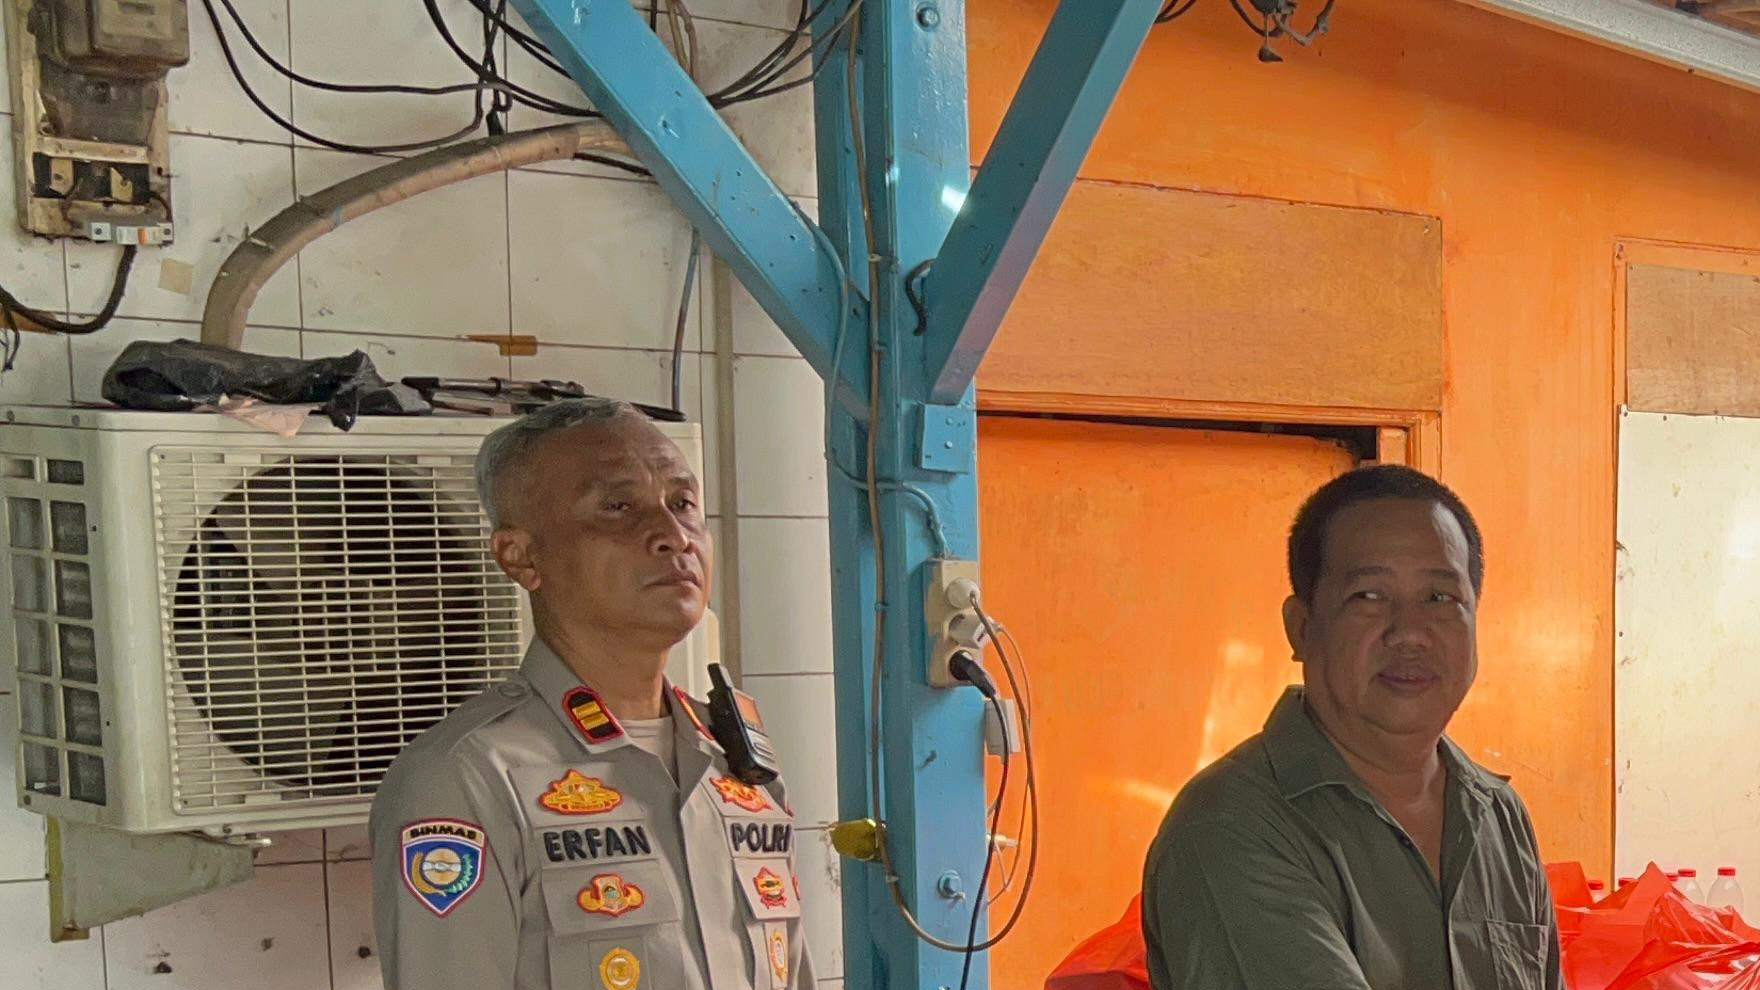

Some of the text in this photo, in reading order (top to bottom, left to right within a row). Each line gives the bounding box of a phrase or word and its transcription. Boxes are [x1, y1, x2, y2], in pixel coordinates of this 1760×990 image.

[409, 825, 478, 840] BINMAS
[543, 826, 652, 862] ERFAN
[730, 822, 792, 853] POLRI
